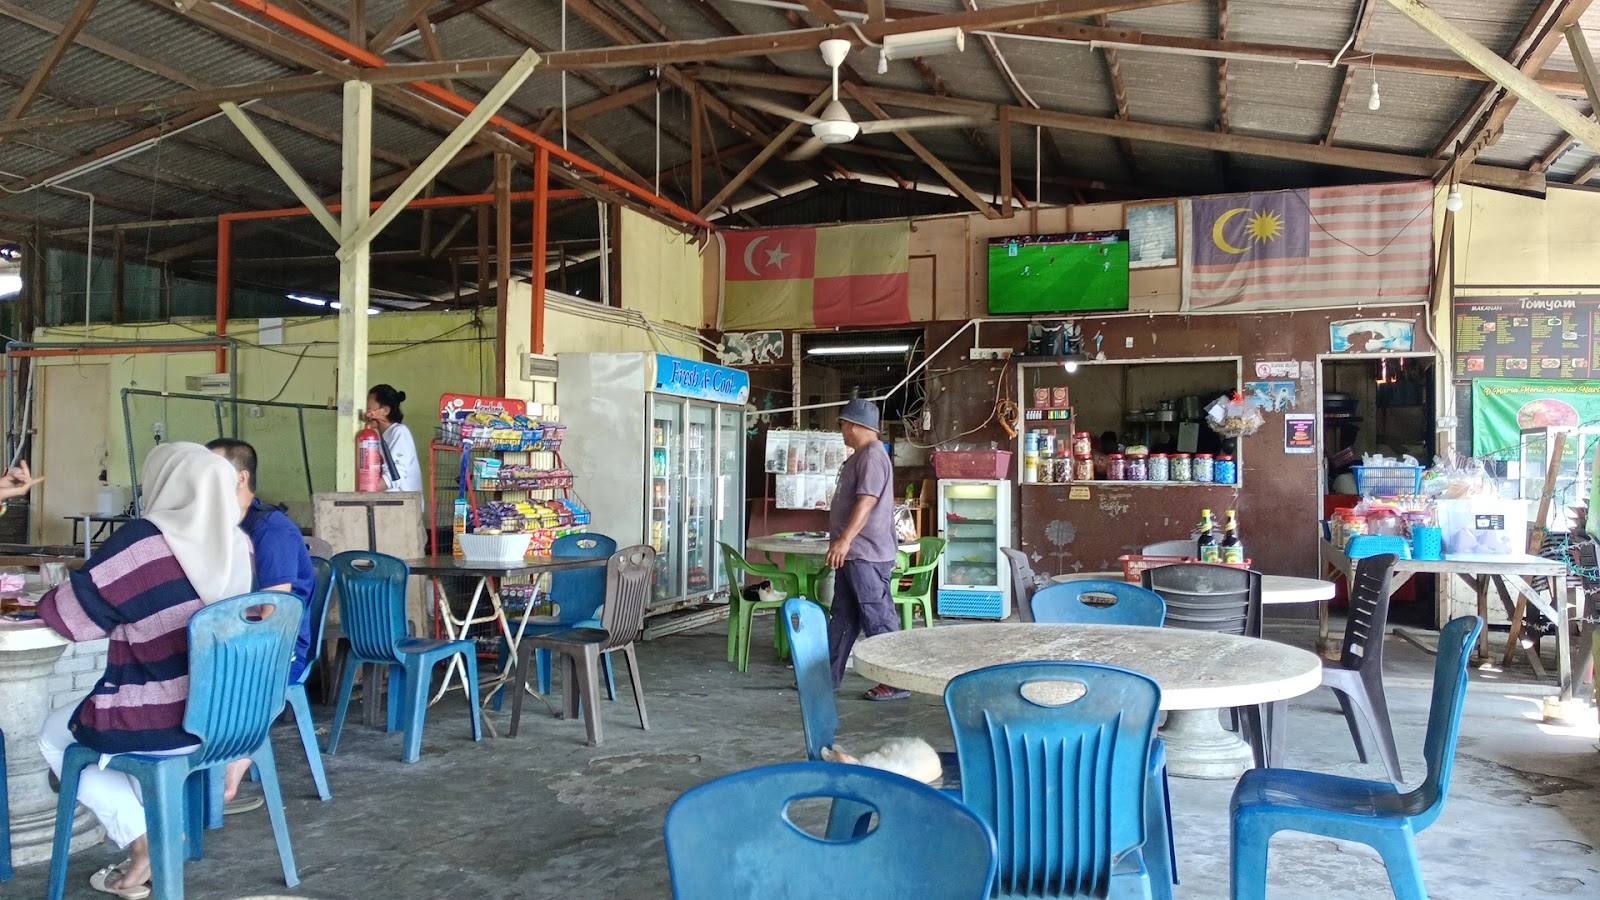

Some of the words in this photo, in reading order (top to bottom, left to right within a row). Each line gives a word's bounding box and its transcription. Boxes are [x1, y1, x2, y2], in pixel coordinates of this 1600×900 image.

[1519, 297, 1576, 310] Tomyam
[670, 360, 700, 387] Fresh
[712, 371, 735, 395] Cool
[1521, 385, 1545, 395] Menu
[1547, 385, 1578, 395] Special
